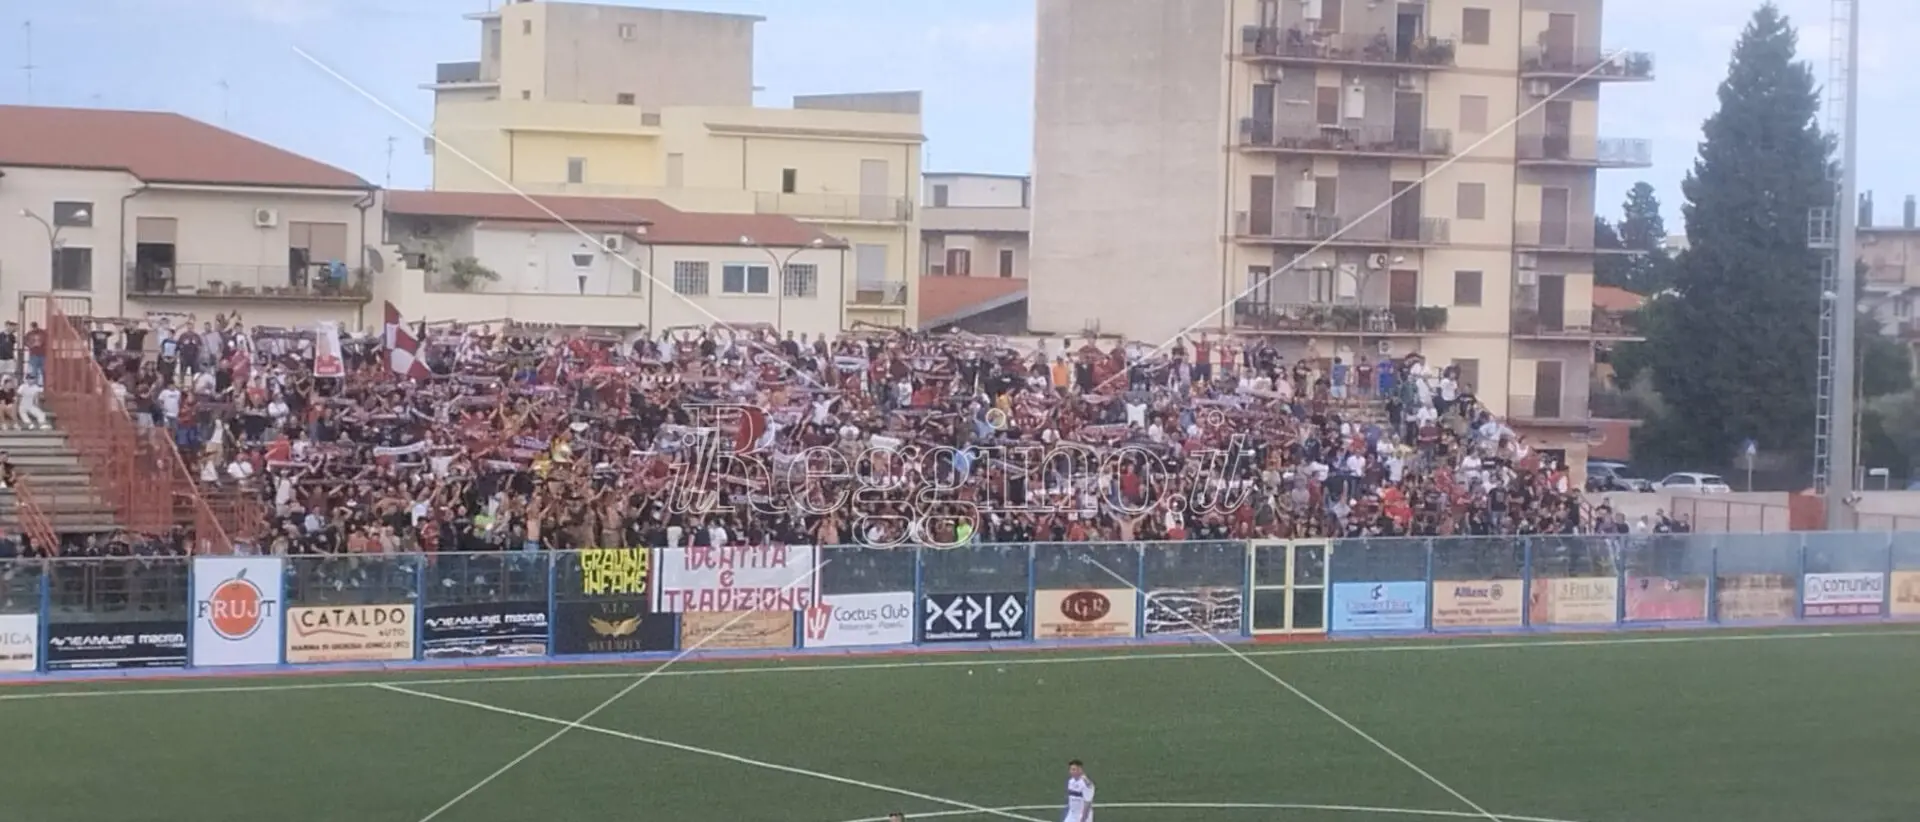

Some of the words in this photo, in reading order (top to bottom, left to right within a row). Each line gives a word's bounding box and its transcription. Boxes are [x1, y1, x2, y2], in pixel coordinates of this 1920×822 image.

[1454, 586, 1488, 598] Allianz
[301, 608, 405, 627] CATALDO
[881, 603, 910, 619] Club
[925, 595, 1024, 631] PEPLO
